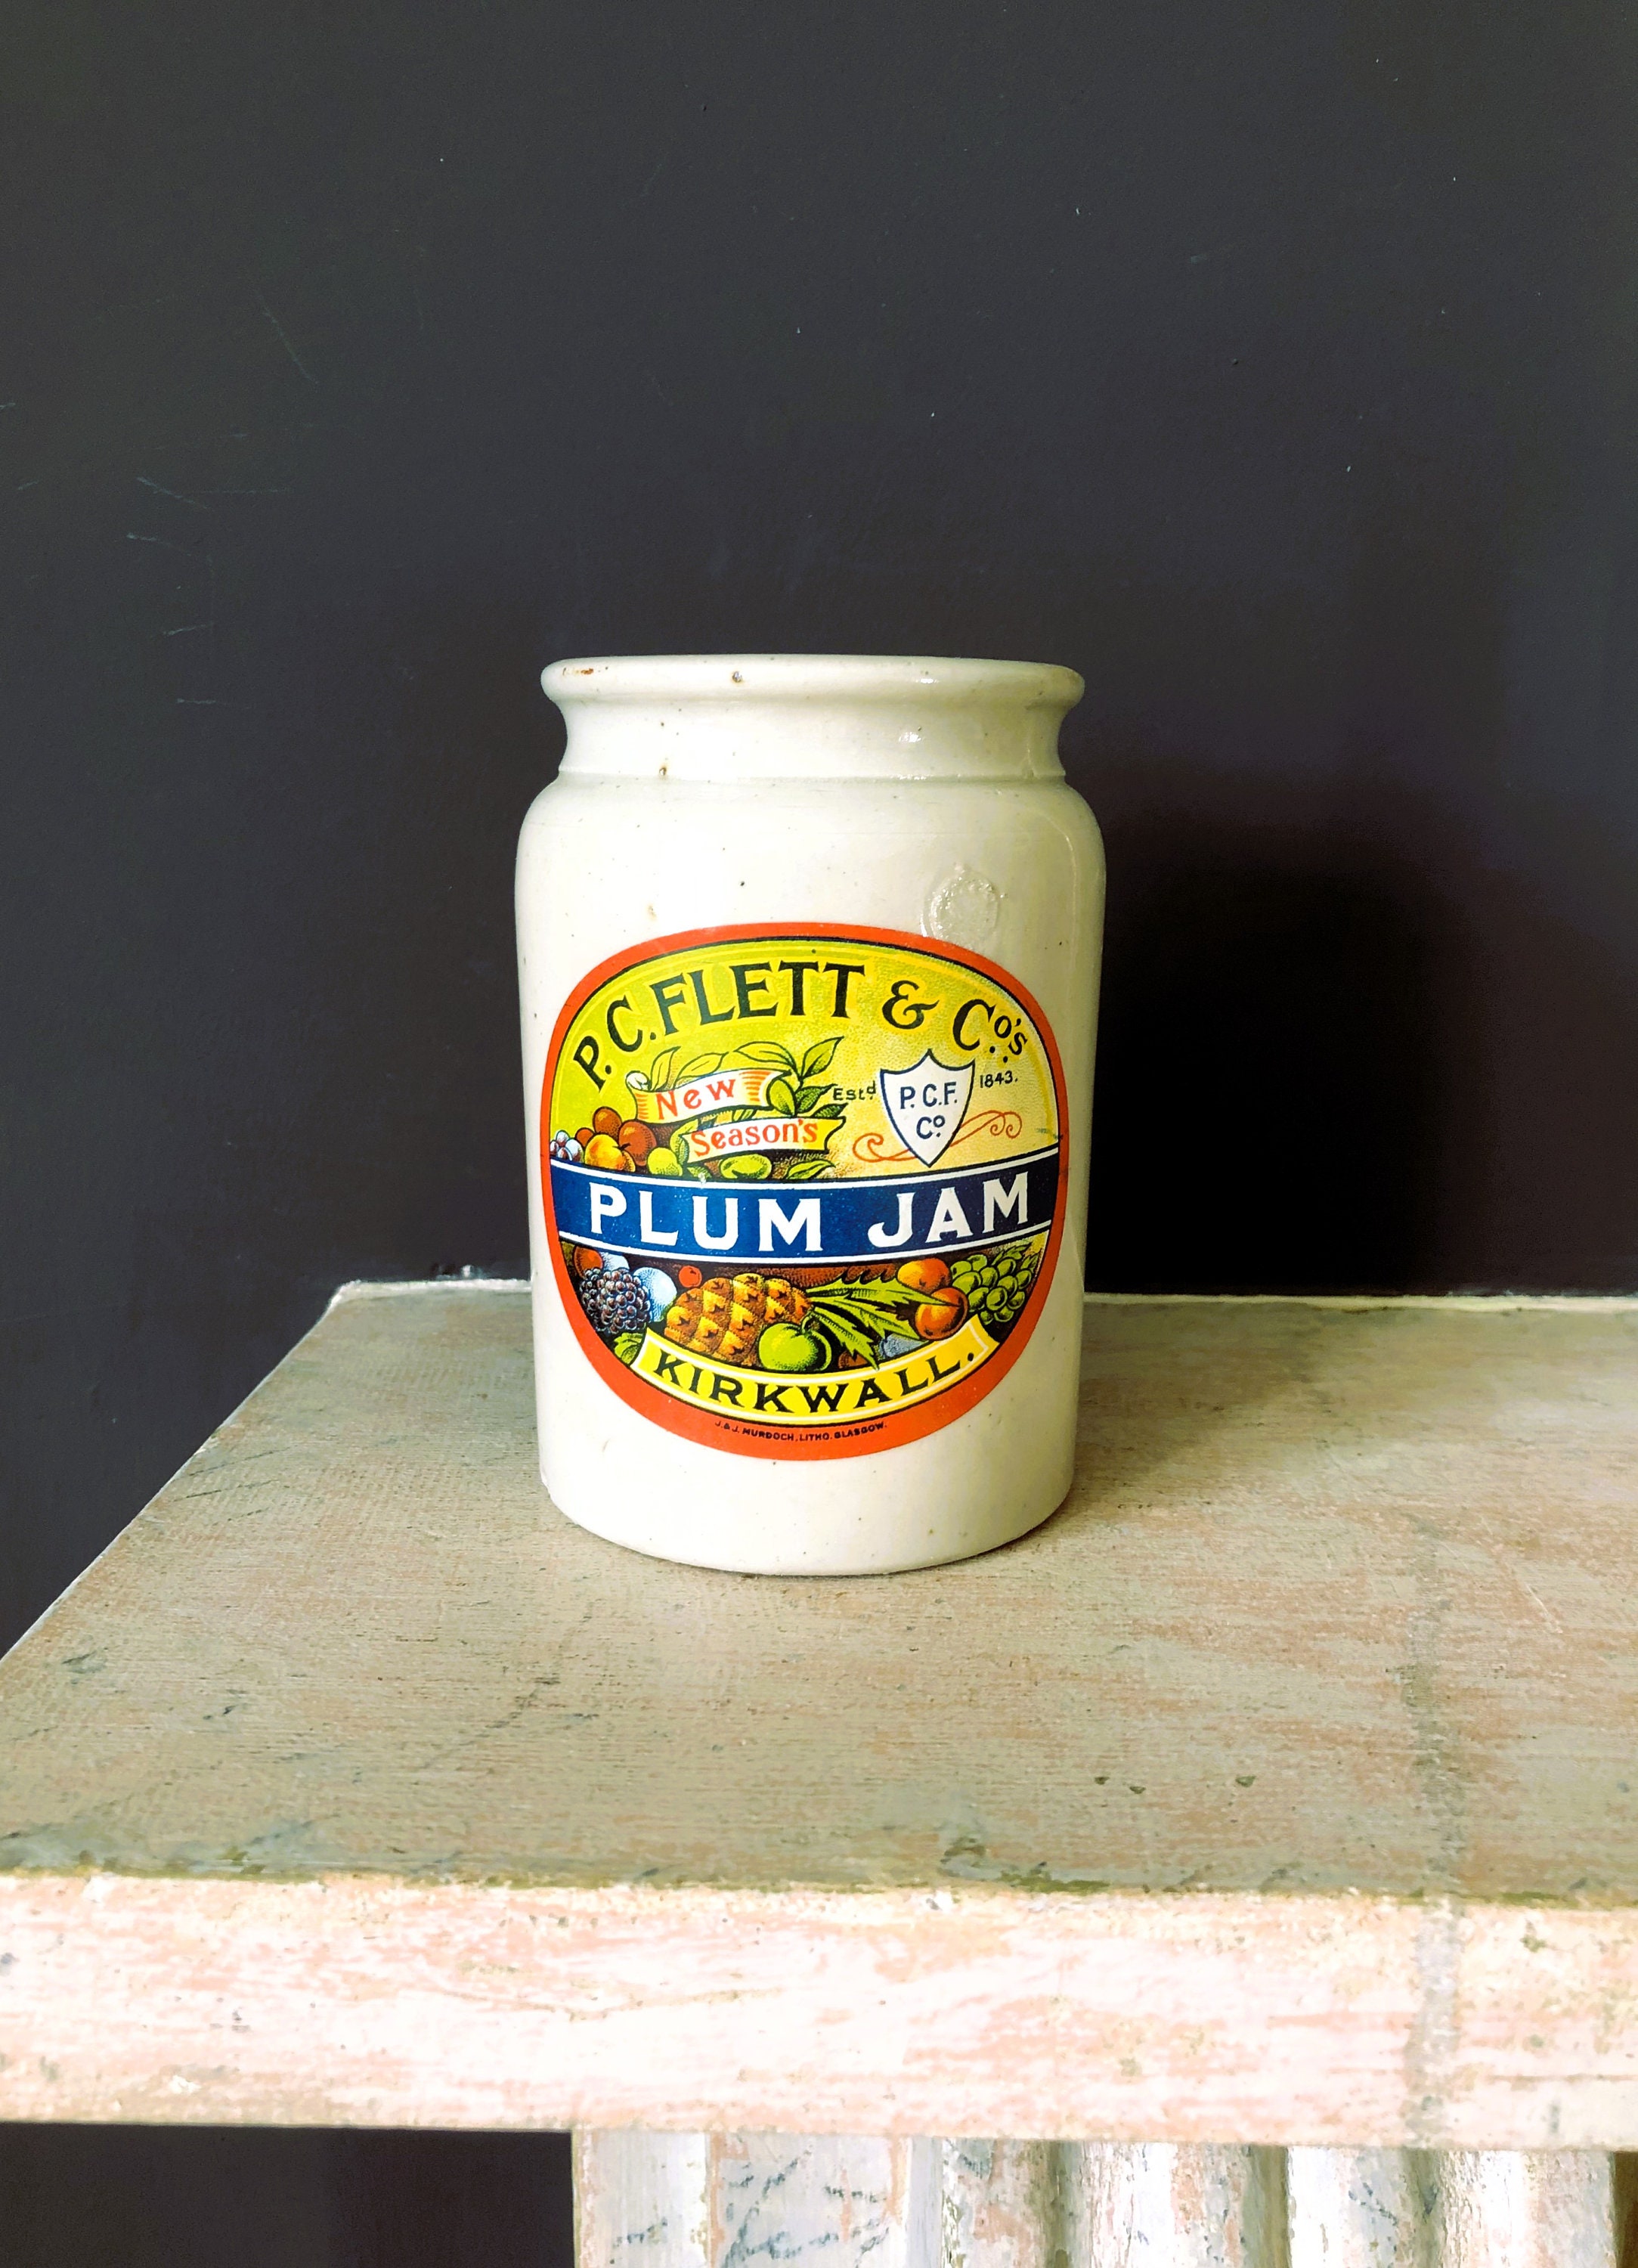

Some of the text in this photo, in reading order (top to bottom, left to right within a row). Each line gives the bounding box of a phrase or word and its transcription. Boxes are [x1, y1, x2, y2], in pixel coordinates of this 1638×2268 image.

[881, 980, 940, 1030] &
[656, 1079, 736, 1120] New
[691, 1118, 818, 1157] Season's
[589, 1171, 1030, 1252] PLUM JAM
[655, 1350, 975, 1414] KIRKWALL.
